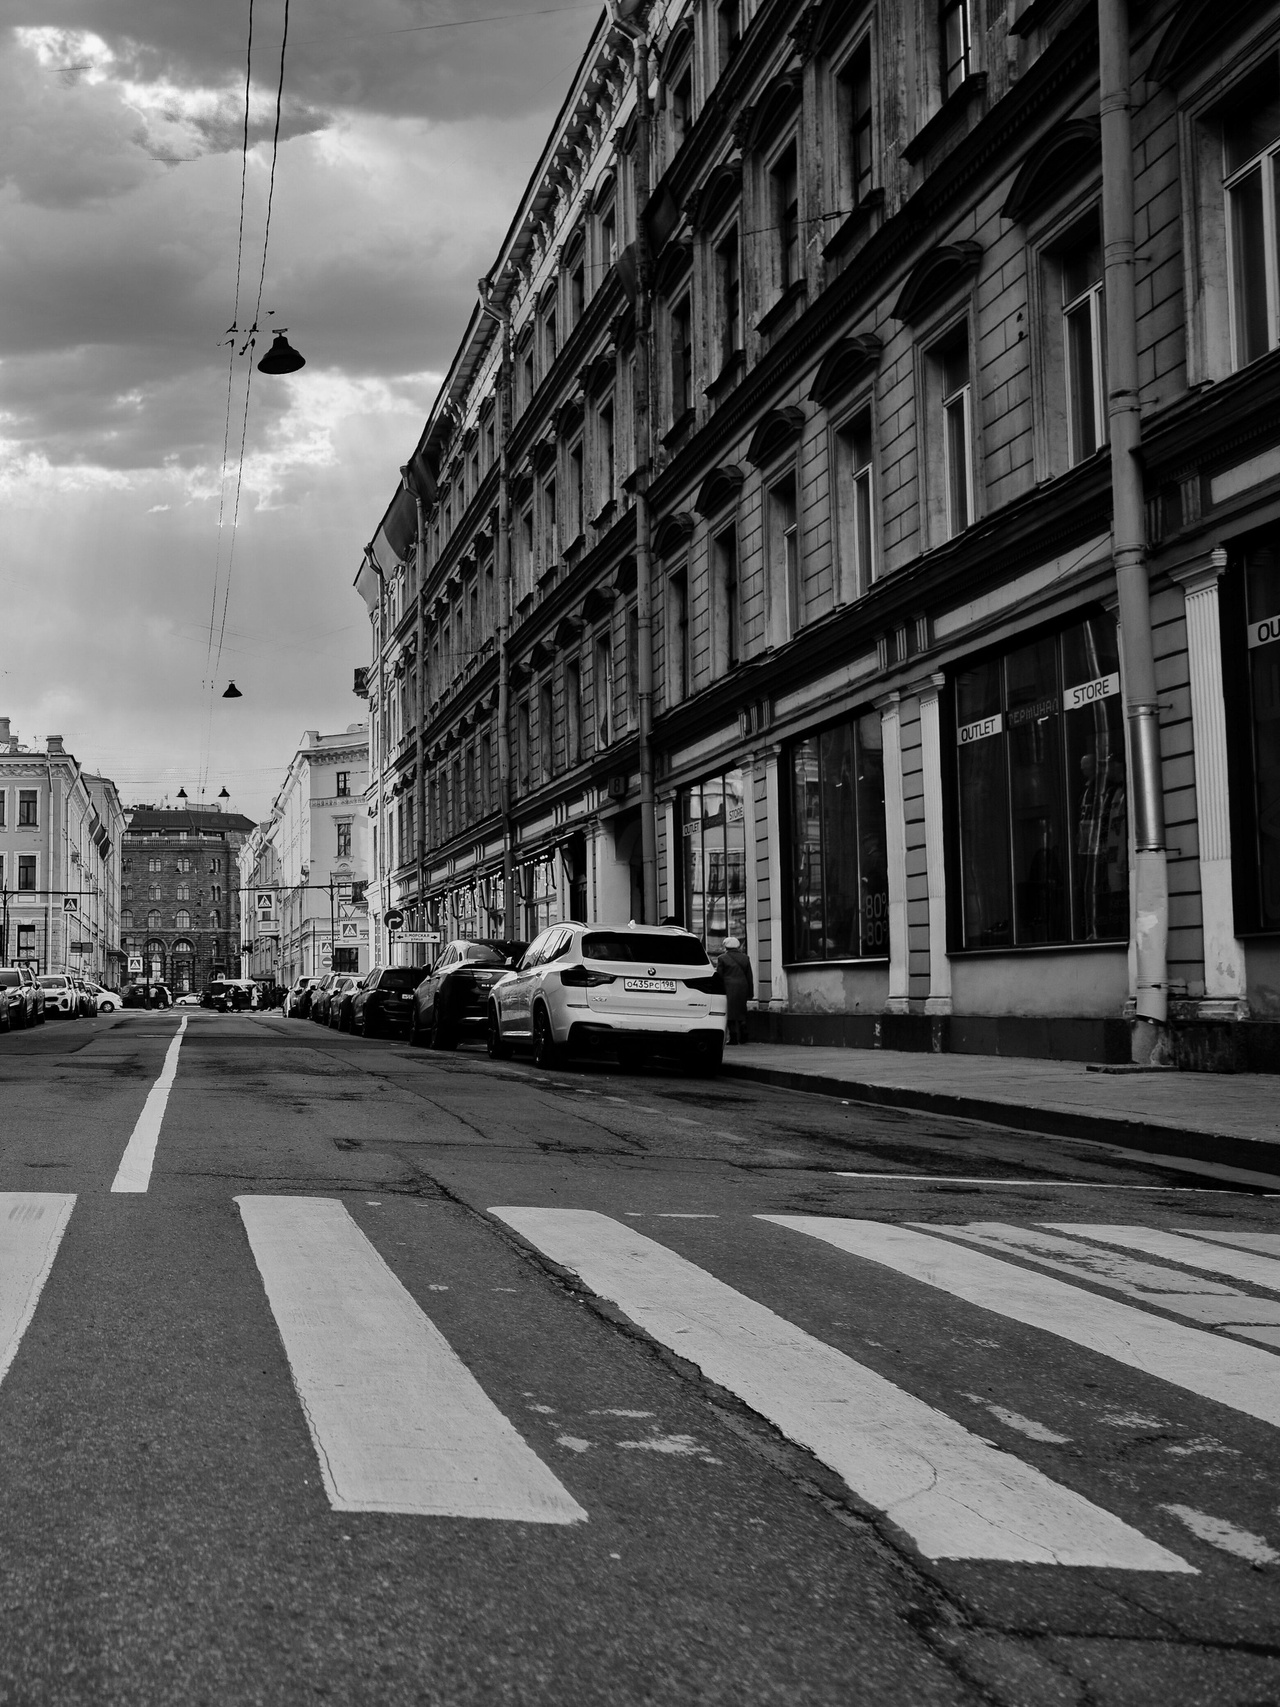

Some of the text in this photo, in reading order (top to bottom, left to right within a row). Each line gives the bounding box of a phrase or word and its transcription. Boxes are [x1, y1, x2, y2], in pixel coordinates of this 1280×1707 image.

[961, 679, 1109, 742] OUTLET STORE
[684, 806, 743, 835] OUTLET STORE
